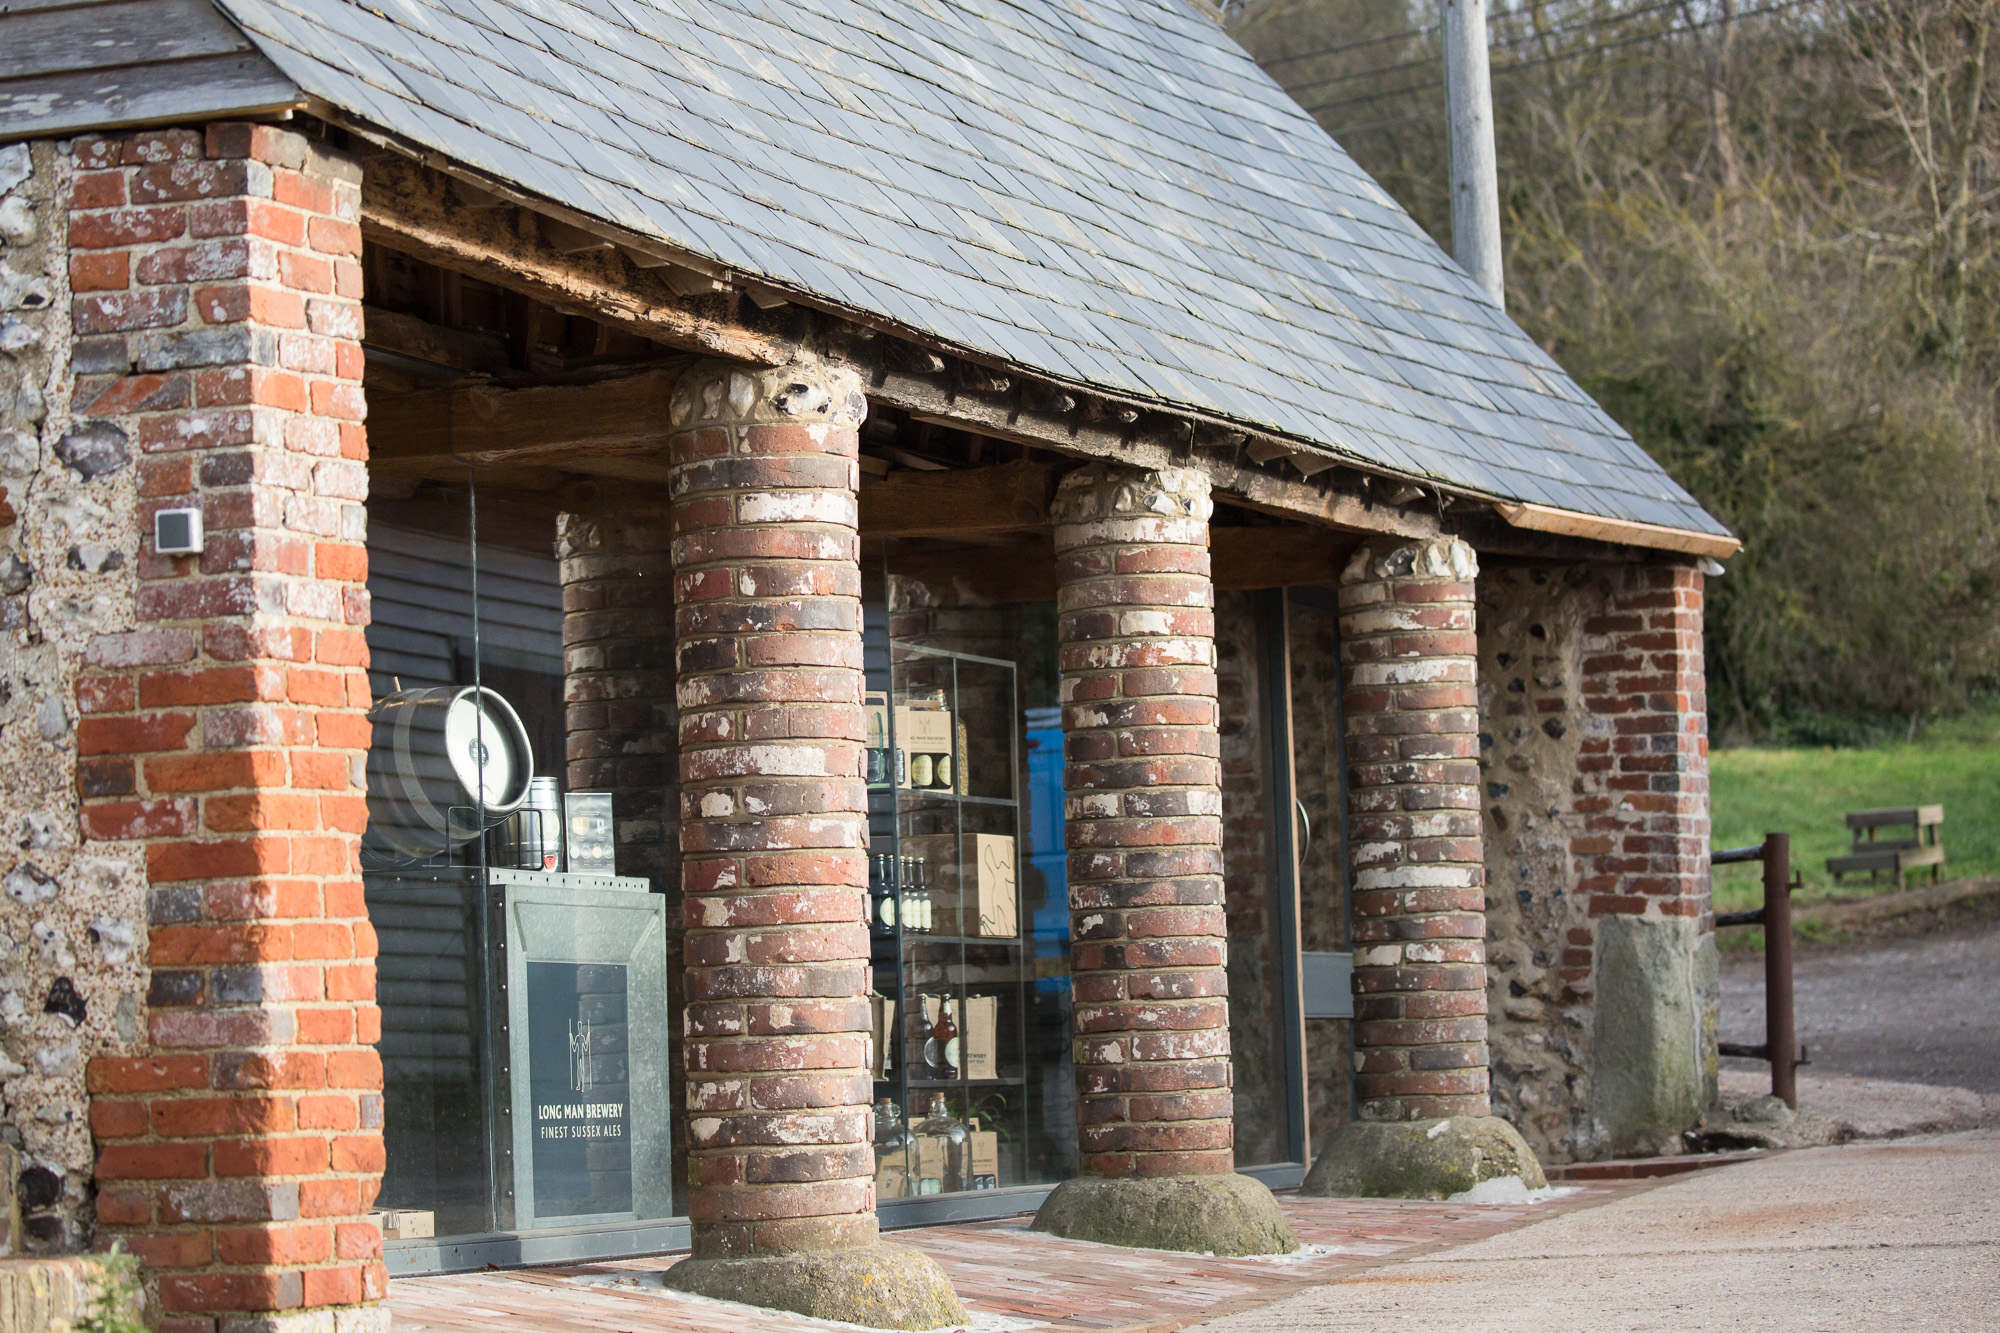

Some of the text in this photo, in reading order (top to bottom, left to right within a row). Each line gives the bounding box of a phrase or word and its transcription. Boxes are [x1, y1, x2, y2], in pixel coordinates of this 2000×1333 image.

[538, 1103, 623, 1120] LONG MAN BREWERY
[541, 1124, 622, 1139] FINEST SUSSEX ALES
